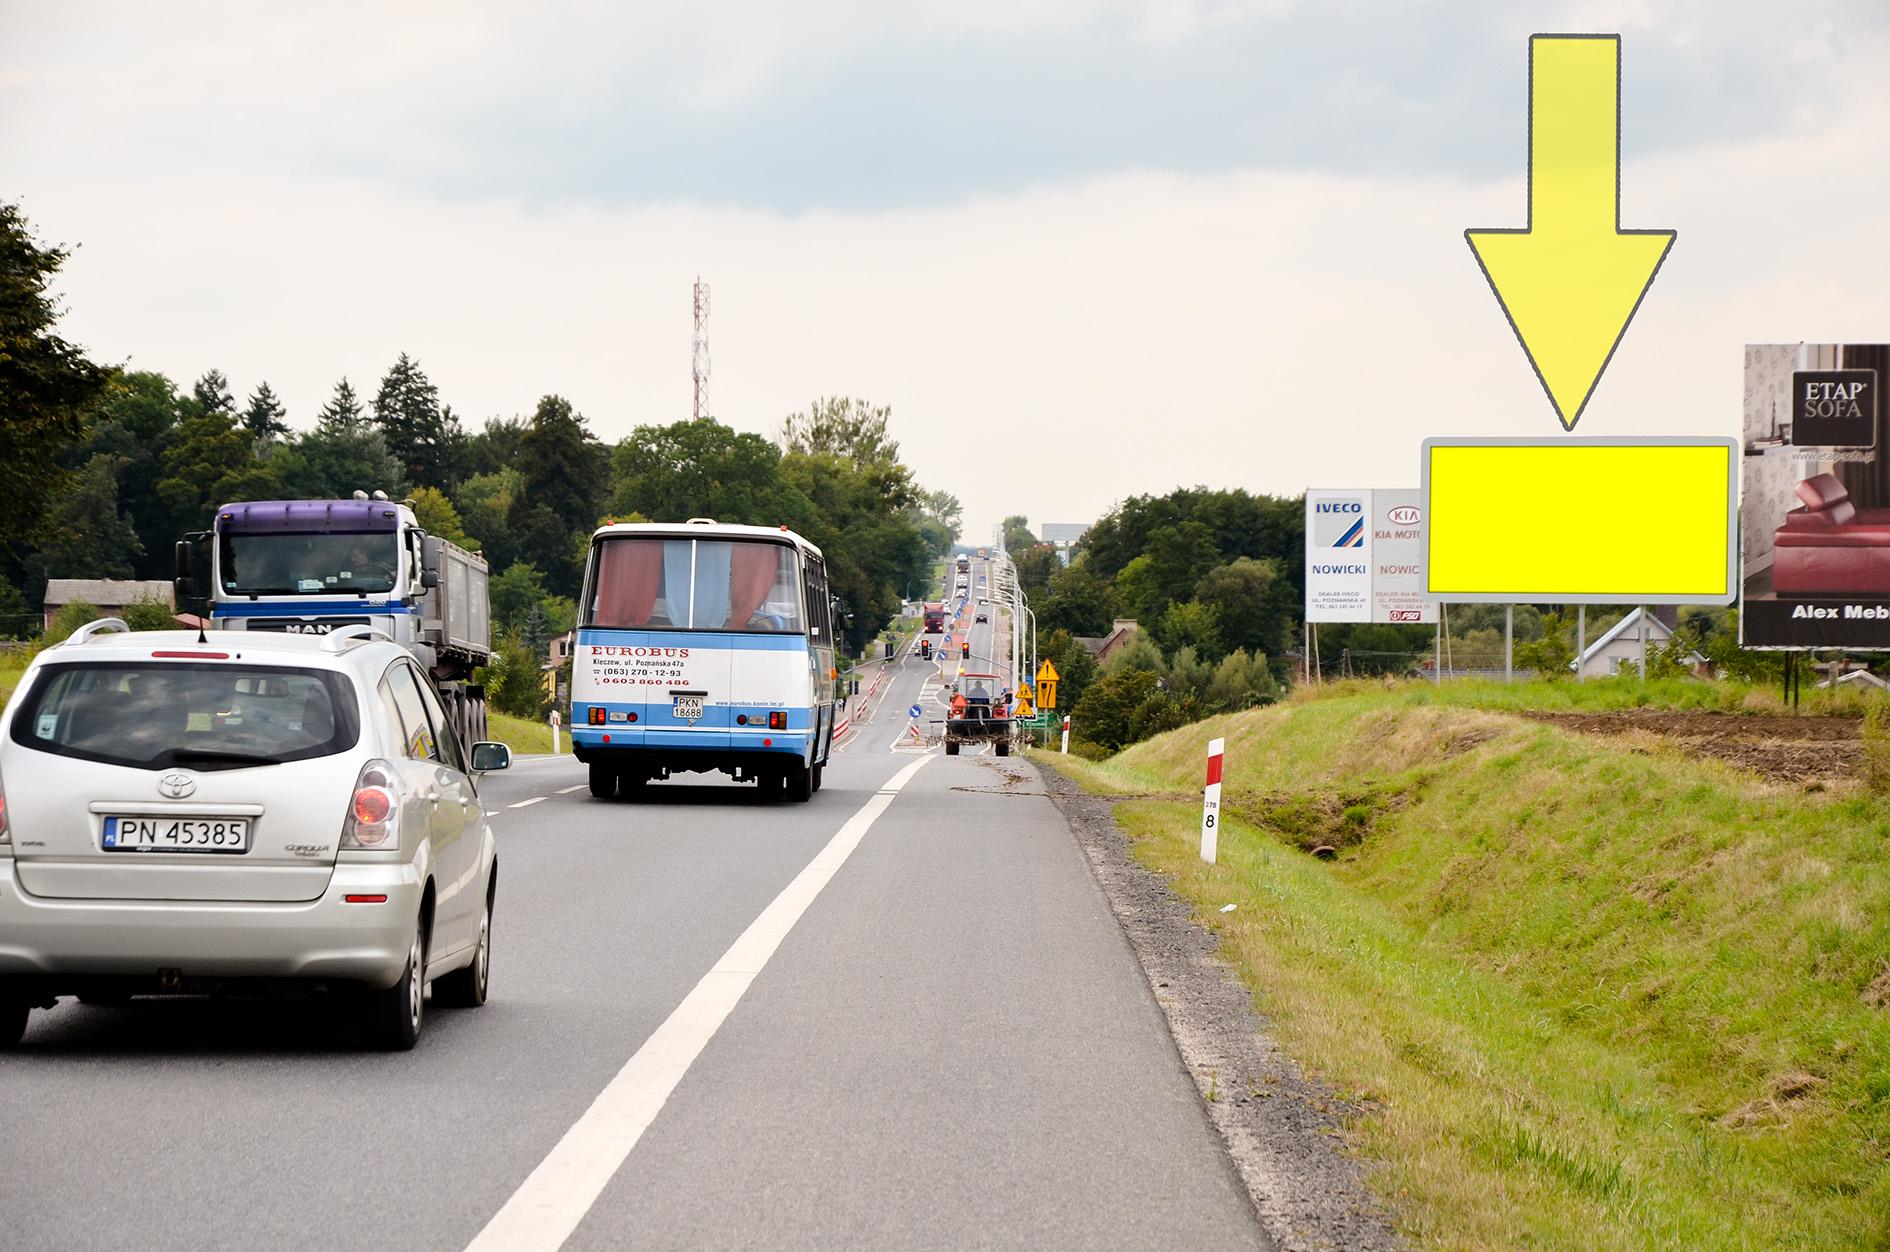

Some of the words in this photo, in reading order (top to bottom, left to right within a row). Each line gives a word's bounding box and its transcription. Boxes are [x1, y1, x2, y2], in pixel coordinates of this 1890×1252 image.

[1805, 382, 1862, 400] ETAP
[1804, 399, 1863, 418] SOFA
[1316, 503, 1361, 513] IVECO
[1394, 510, 1418, 520] KIA
[1375, 530, 1391, 539] KIA
[1312, 565, 1366, 574] NOWICKI
[1401, 611, 1420, 620] FSO
[1791, 604, 1839, 619] Alex
[1844, 604, 1890, 619] Meb
[286, 624, 332, 634] MAN
[591, 646, 689, 658] EUROBUS
[592, 658, 622, 666] Kleczew,
[603, 668, 628, 676] (063)
[679, 698, 699, 708] PKN
[675, 708, 702, 717] 18688
[1205, 814, 1215, 828] 8
[120, 821, 156, 843] PN
[166, 821, 241, 845] 45385
